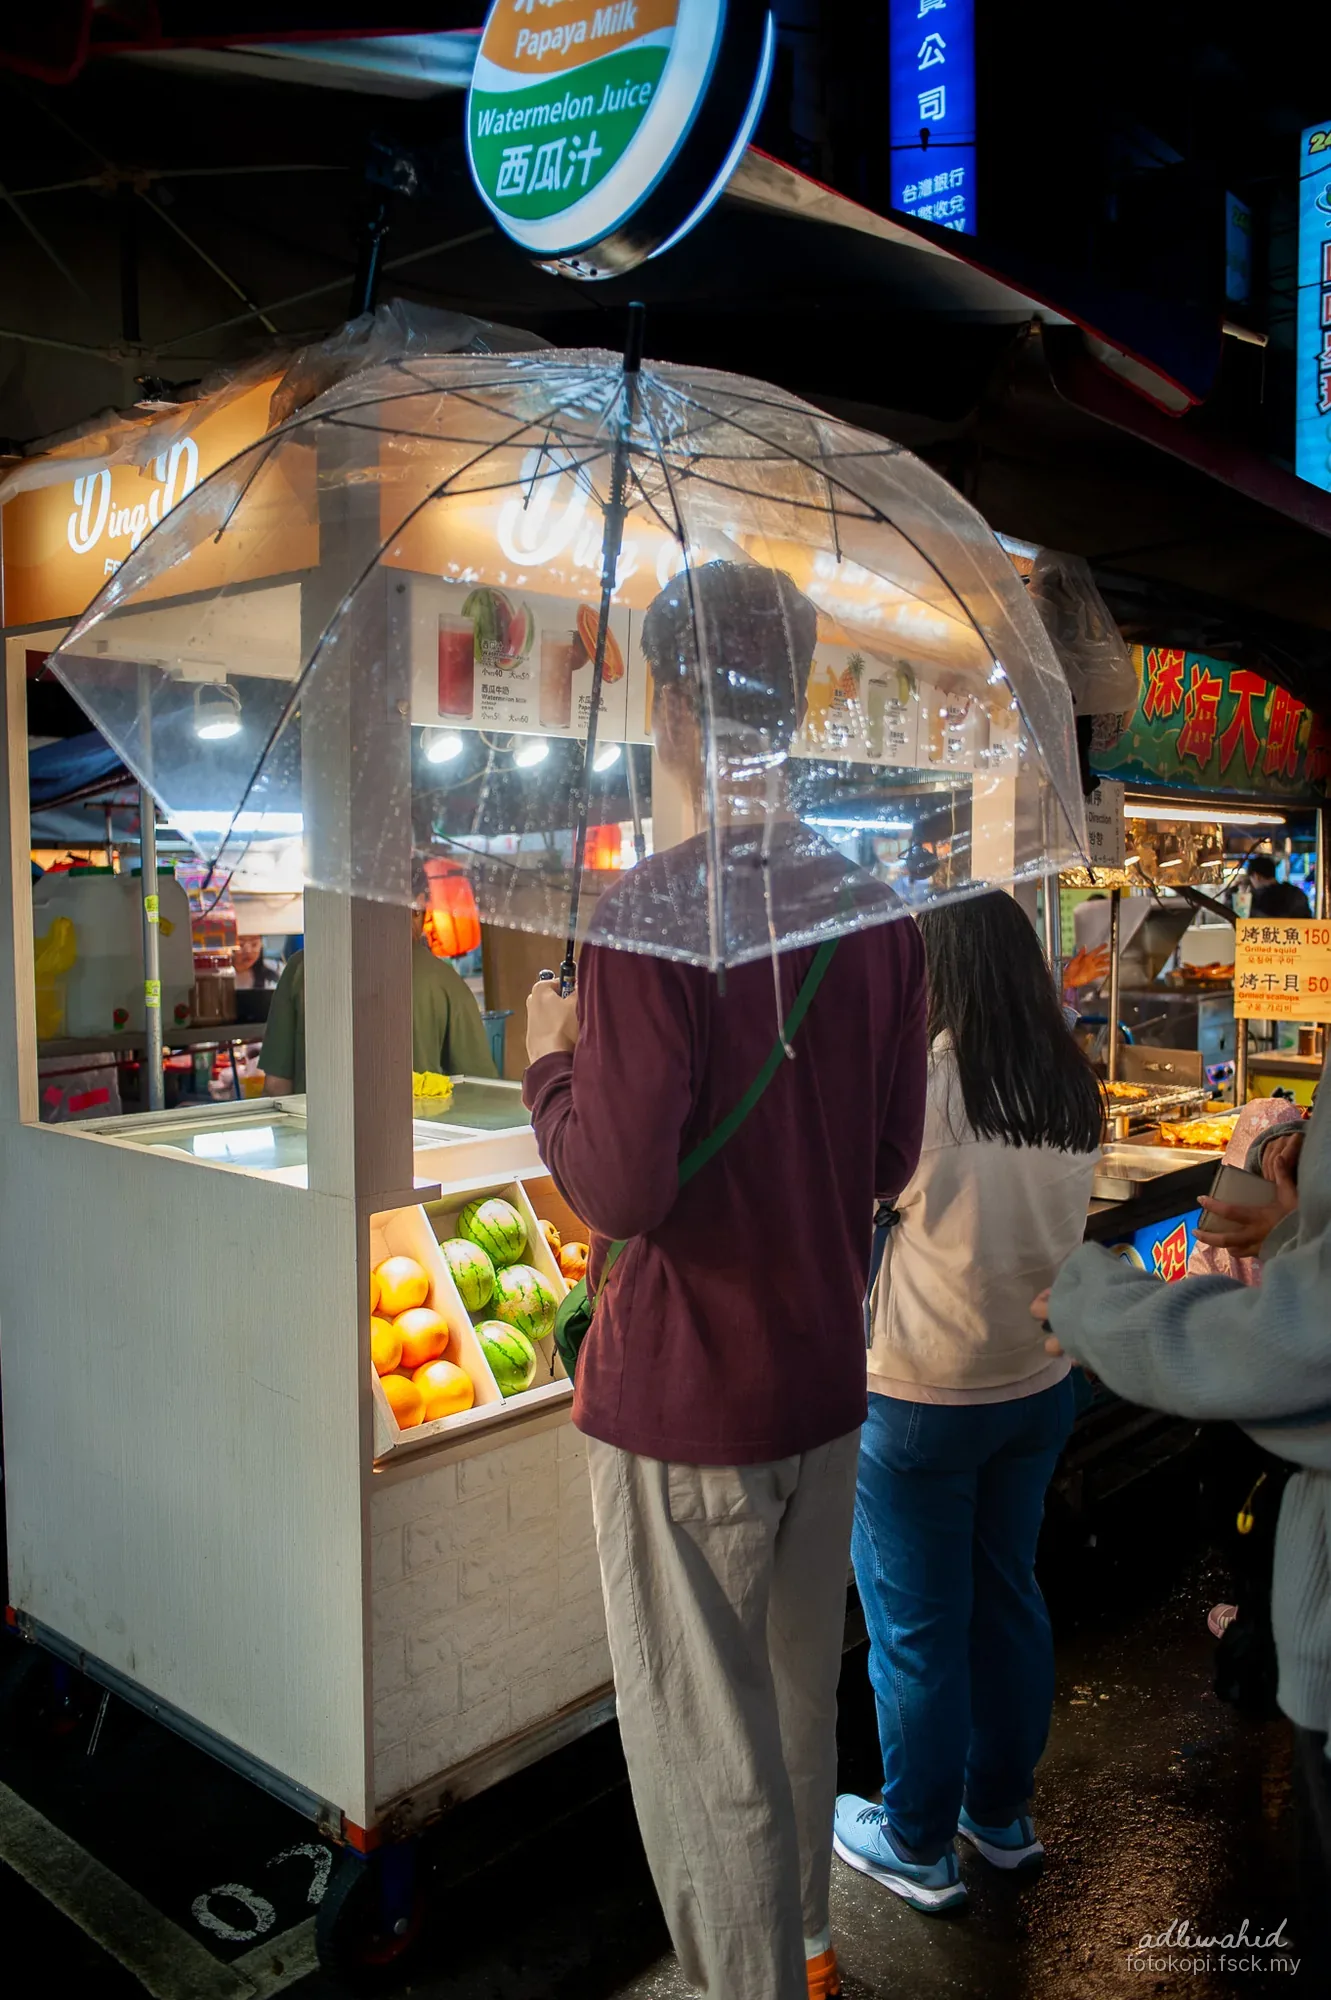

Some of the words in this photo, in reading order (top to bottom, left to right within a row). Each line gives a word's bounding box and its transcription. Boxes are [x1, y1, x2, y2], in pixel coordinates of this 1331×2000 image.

[514, 19, 588, 61] Papaya
[590, 2, 638, 40] Milk
[477, 91, 594, 137] Watermelon
[597, 80, 651, 114] Juice
[496, 130, 603, 197] 西瓜汁
[67, 468, 149, 554] Ding
[1240, 926, 1302, 945] 烤魷魚
[1304, 928, 1330, 945] 150
[1244, 945, 1272, 954] Grilled
[1273, 947, 1298, 956] squid
[1238, 991, 1265, 999] Grilled
[1266, 994, 1300, 1002] scallops
[1239, 972, 1300, 992] 烤干貝
[1307, 976, 1329, 993] 50
